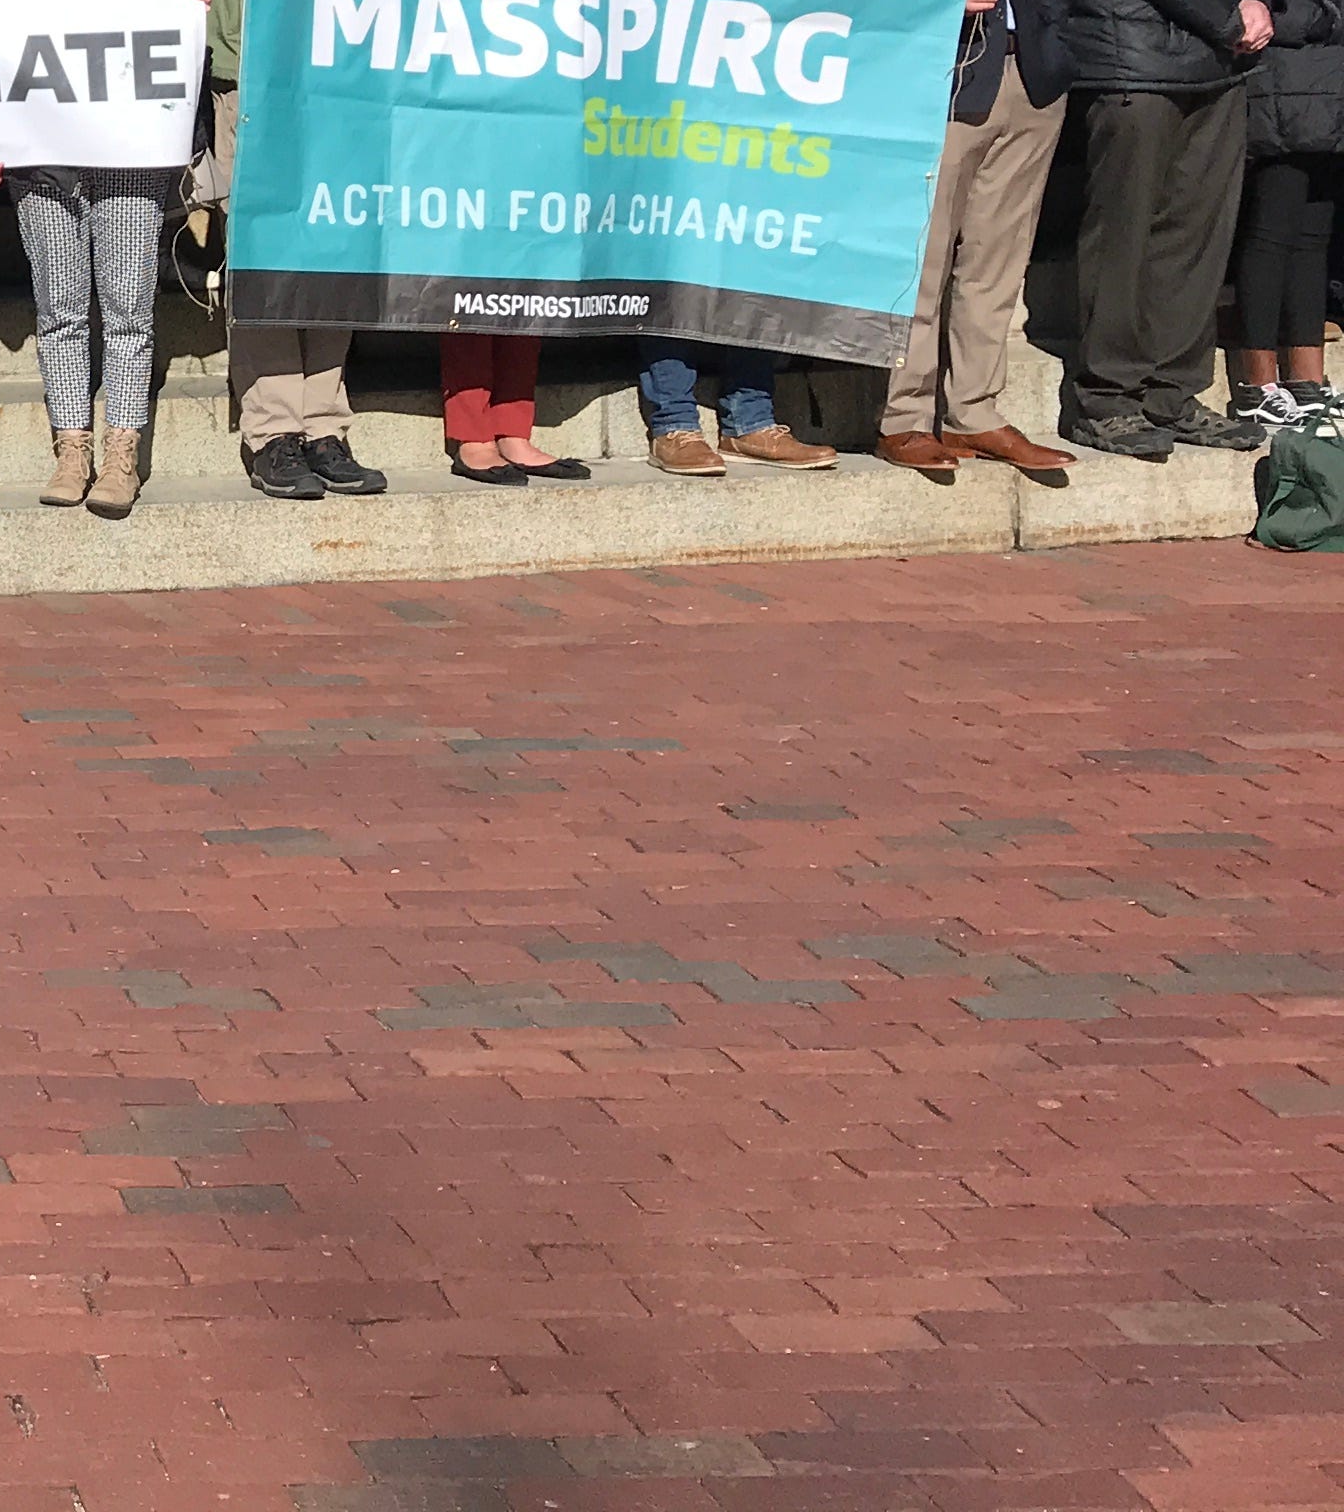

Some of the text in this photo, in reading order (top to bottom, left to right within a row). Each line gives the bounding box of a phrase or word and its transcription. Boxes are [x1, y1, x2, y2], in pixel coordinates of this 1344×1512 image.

[582, 96, 832, 179] Students
[307, 182, 823, 256] ACTION FOR A CHANGE
